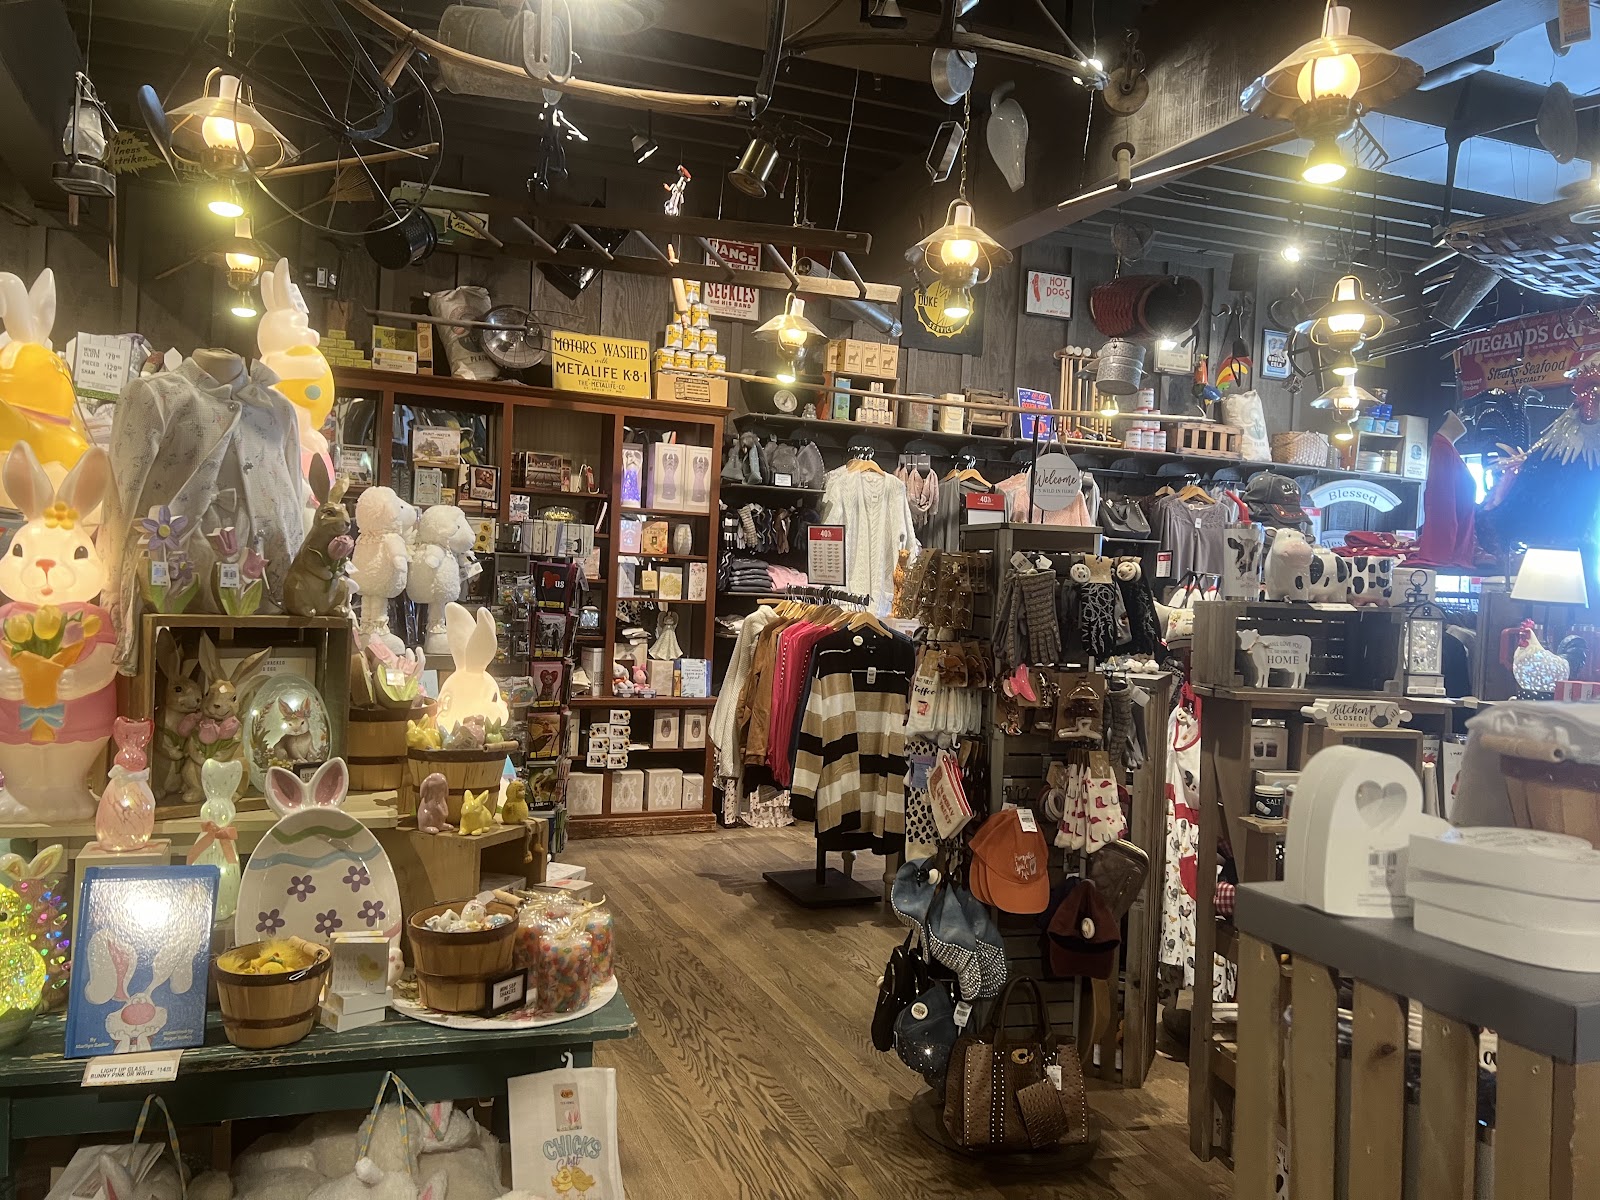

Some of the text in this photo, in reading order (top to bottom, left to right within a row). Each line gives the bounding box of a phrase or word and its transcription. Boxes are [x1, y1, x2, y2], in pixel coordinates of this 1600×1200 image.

[113, 134, 133, 146] hen
[1049, 276, 1067, 288] HOT
[707, 283, 756, 304] SECKLES
[1046, 286, 1070, 300] DOGS
[918, 295, 938, 307] DUKE
[928, 322, 955, 333] SERVICE
[554, 336, 648, 361] MOTORS WASHED
[556, 360, 618, 380] METALIFE
[1034, 468, 1078, 488] Welcome
[1328, 488, 1379, 506] Blessed
[1267, 655, 1299, 665] HOME
[1330, 702, 1369, 716] Kitchen
[1333, 714, 1368, 722] CLOSED!
[1266, 798, 1281, 806] SALT
[100, 1066, 117, 1074] LIGHT
[135, 1069, 154, 1077] WHITE
[542, 1134, 602, 1161] CHICKS
